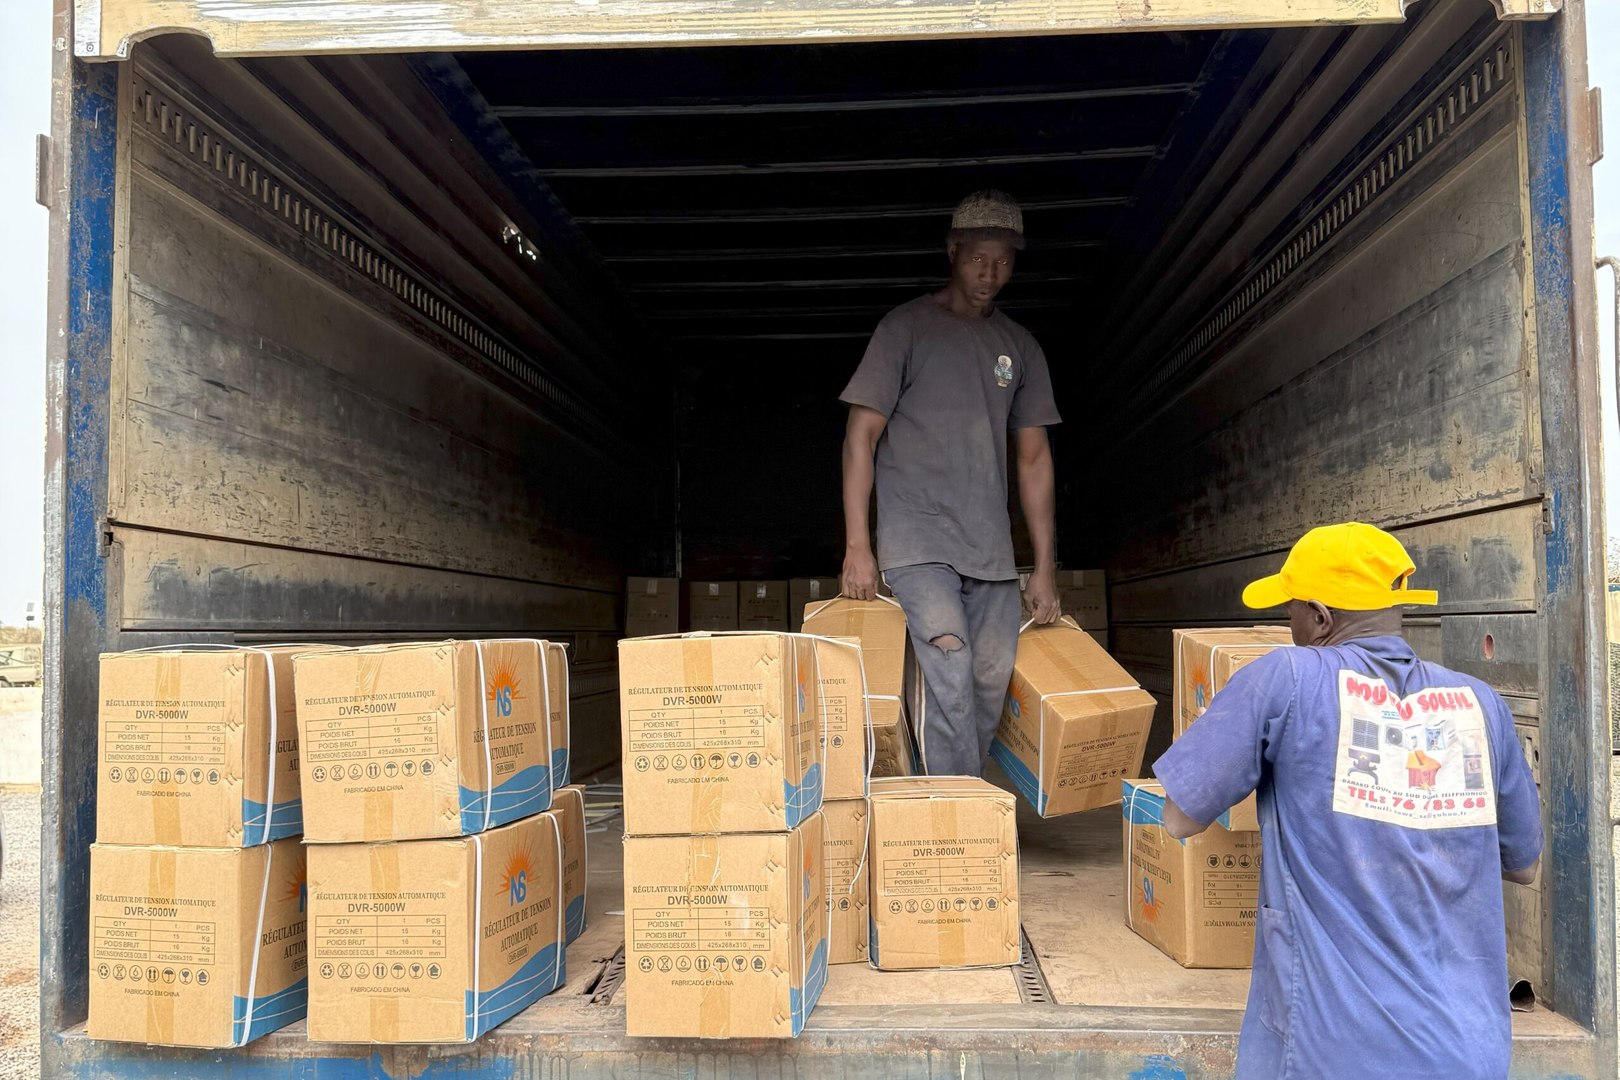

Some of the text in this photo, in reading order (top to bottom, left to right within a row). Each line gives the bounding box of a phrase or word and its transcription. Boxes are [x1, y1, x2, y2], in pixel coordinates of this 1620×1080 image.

[629, 686, 671, 695] RÉGULATEUR
[714, 683, 762, 692] AUTOMATIQUE
[306, 696, 347, 706] RÉGULATEUR
[358, 694, 386, 702] TENSION
[388, 690, 435, 700] AUTOMATIQUE
[496, 686, 512, 718] NS
[662, 695, 722, 706] DVR-5000W
[1417, 692, 1473, 712] SOLEIL
[135, 710, 188, 719] DVR-5000W
[338, 703, 396, 716] DVR-5000W
[516, 722, 536, 736] TENSION
[1342, 779, 1369, 788] BAMAKO
[1392, 796, 1415, 810] 76
[1463, 797, 1486, 808] 68
[913, 848, 964, 856] DVR-5000W
[510, 870, 527, 907] NS
[96, 893, 134, 903] RÉGULATEUR
[171, 898, 215, 908] AUTOMATIQUE
[667, 896, 727, 905] DVR-5000W
[124, 906, 177, 918] DVR-5000W
[348, 903, 406, 912] DVR-5000W
[484, 897, 551, 939] RÉGULATEUR DE TENSION
[501, 922, 539, 952] AUTOMATIQUE
